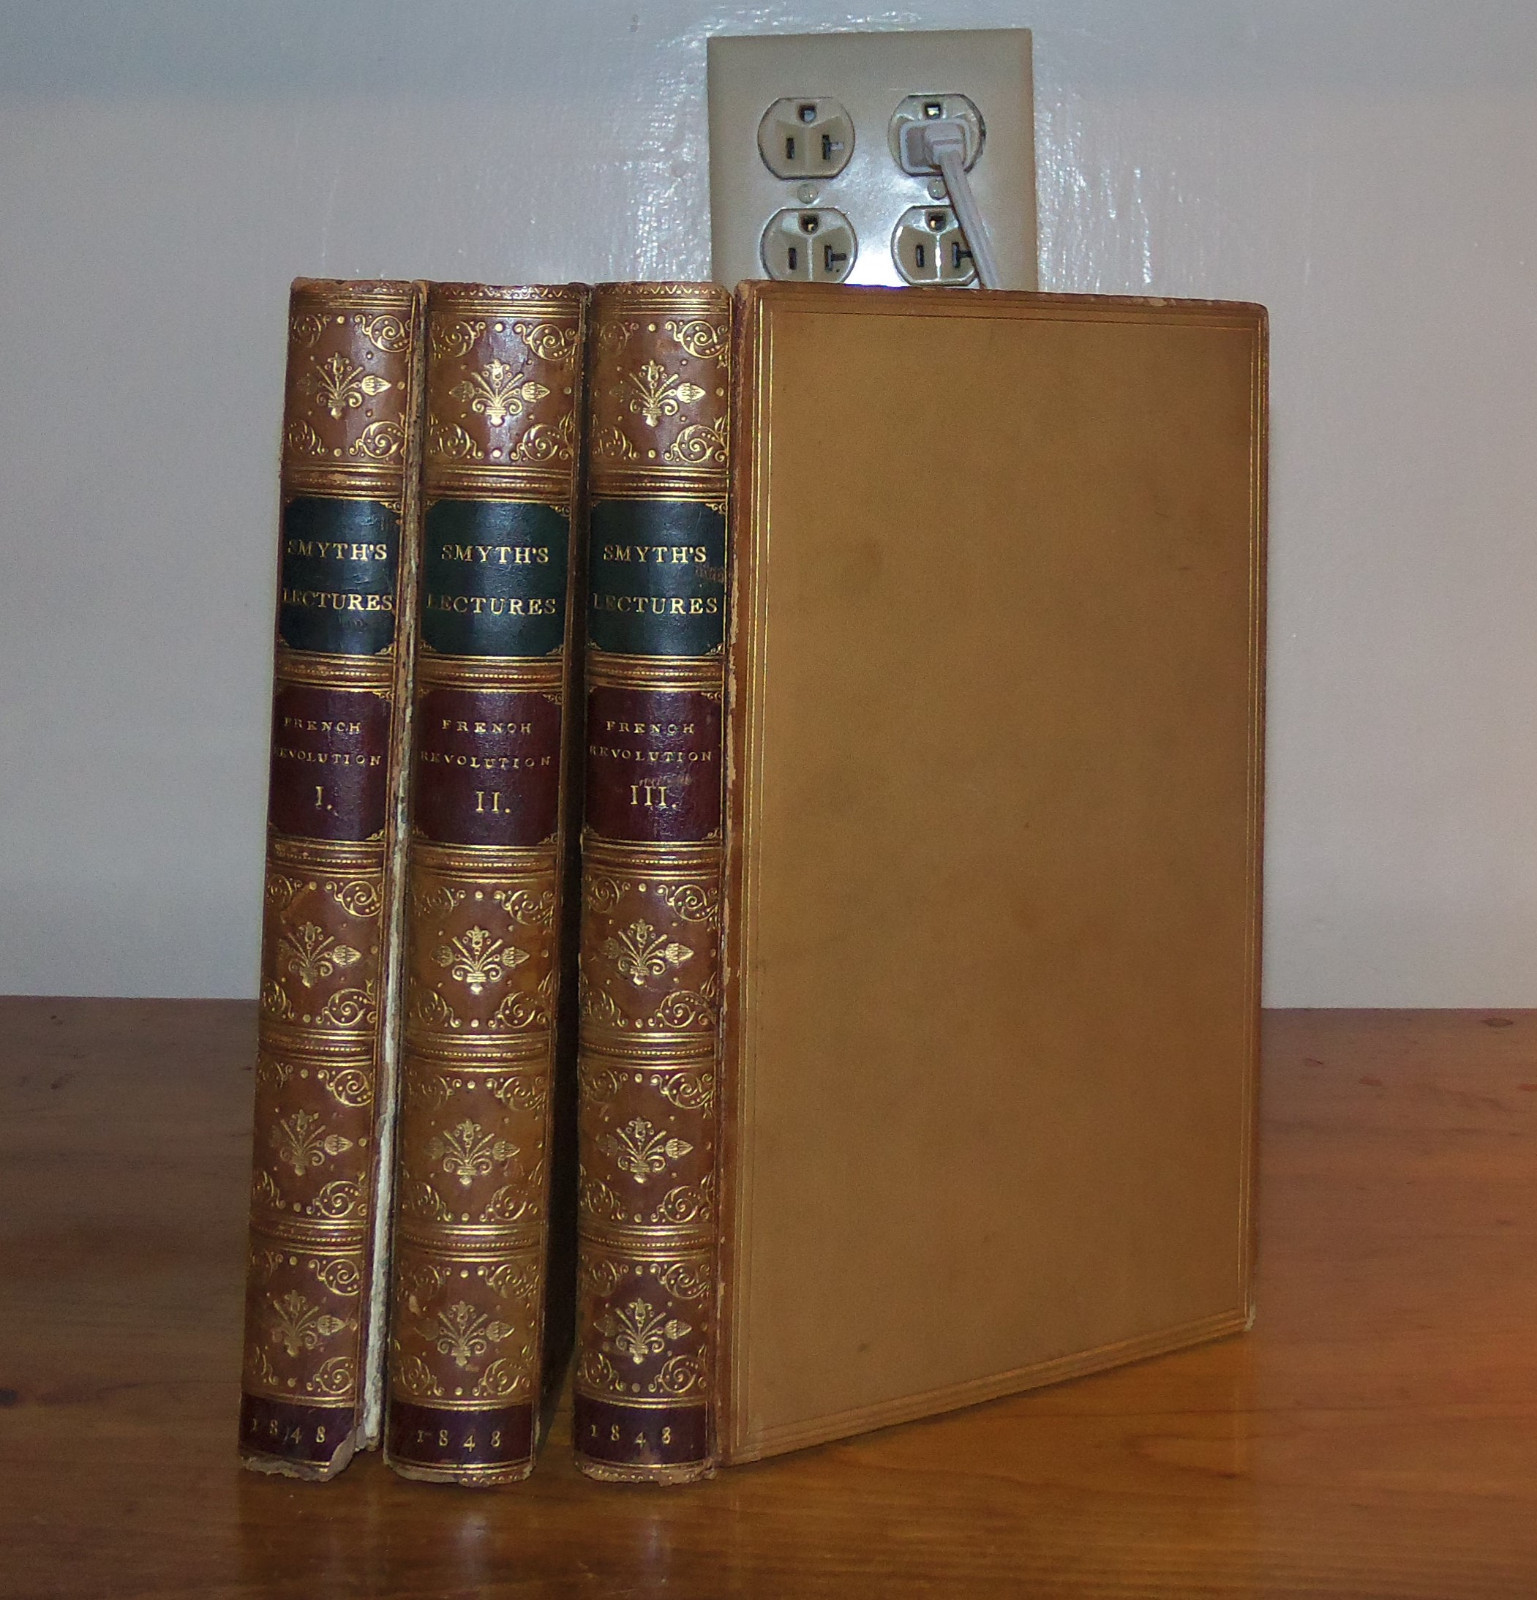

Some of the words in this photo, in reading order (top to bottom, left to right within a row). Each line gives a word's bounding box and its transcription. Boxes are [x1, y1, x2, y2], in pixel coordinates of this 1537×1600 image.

[287, 540, 388, 561] SMYTH'S
[441, 544, 550, 564] SMYTH'S
[603, 544, 707, 563] SMYTH'S
[282, 587, 393, 611] LECTURES
[426, 593, 556, 615] LECTURES
[593, 592, 718, 615] LECTURES
[284, 717, 361, 733] FRENCH
[441, 719, 532, 734] FRENCH
[606, 720, 695, 734] FRENCH
[274, 746, 382, 766] EVOLUTION
[420, 751, 551, 769] REVOLUTION
[589, 745, 712, 762] REVOLUTION
[475, 791, 511, 814] II.
[630, 785, 677, 808] III.
[591, 1424, 671, 1448] 1848
